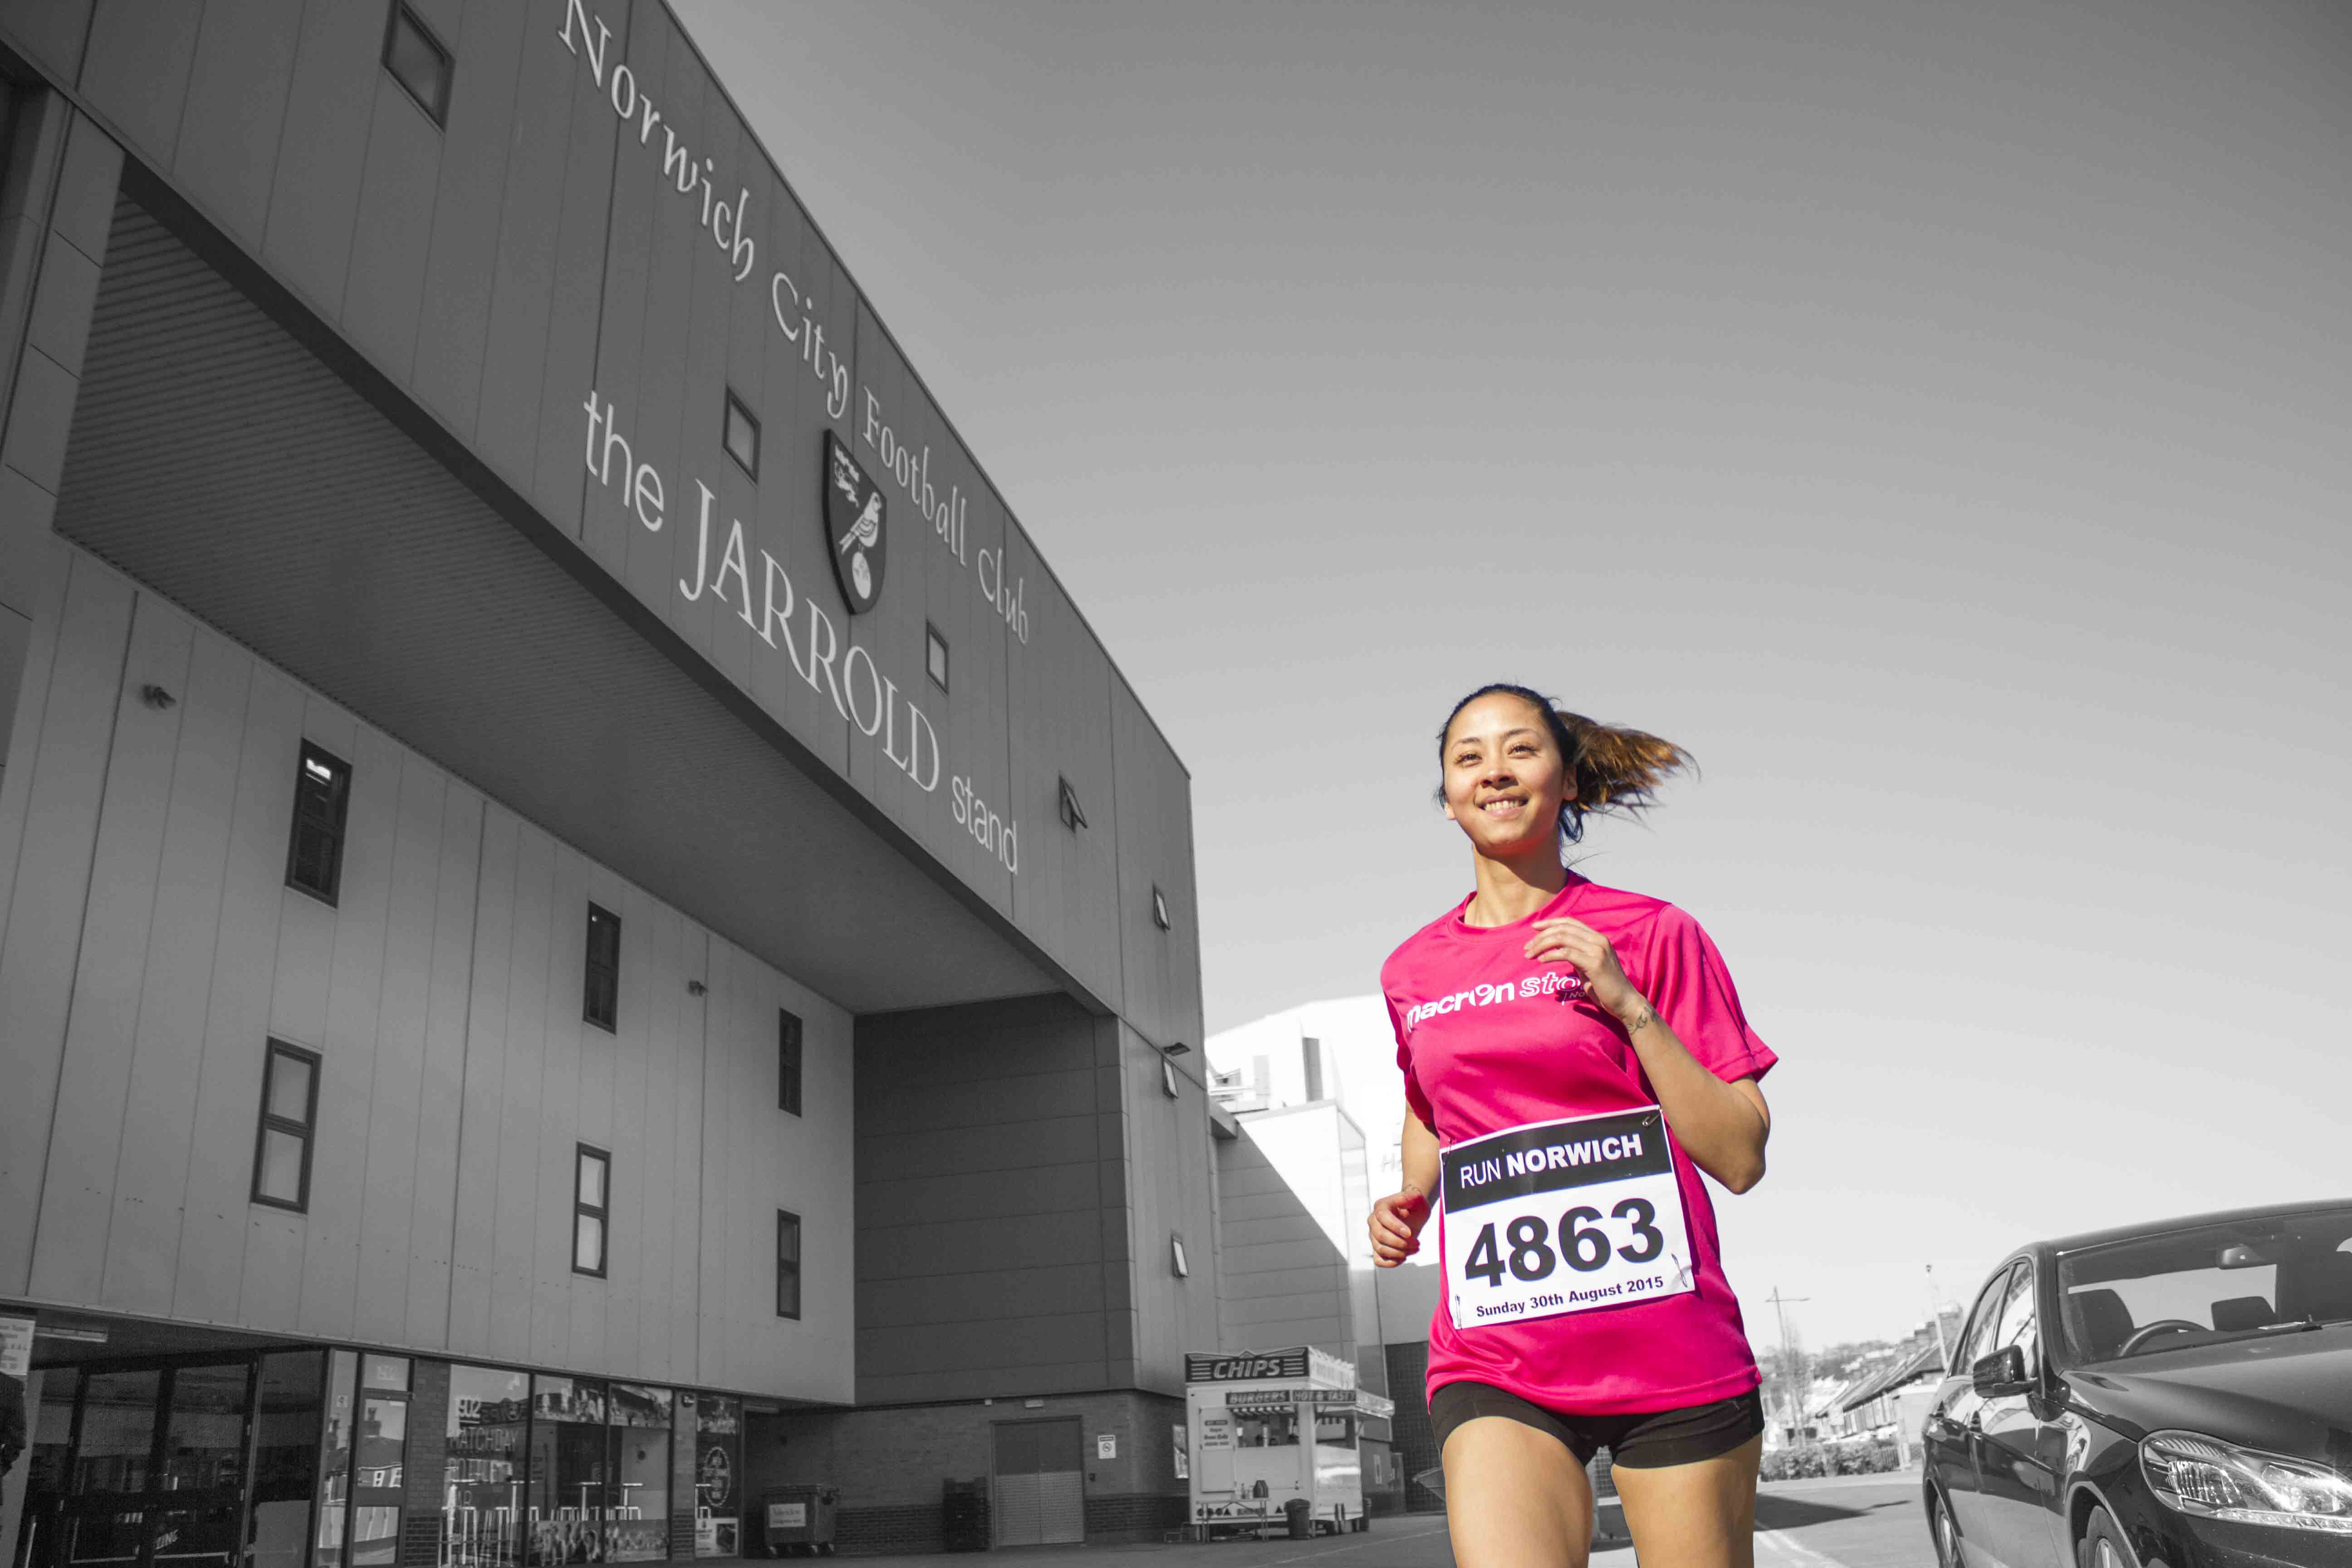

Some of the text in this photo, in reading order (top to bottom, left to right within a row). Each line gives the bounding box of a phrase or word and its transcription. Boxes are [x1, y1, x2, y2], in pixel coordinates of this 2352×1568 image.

[559, 0, 755, 281] Norwich
[771, 272, 848, 419] City
[862, 386, 966, 566] Football
[583, 390, 1018, 875] the JARROLD stand
[1460, 1132, 1643, 1189] RUN NORWICH
[1464, 1197, 1665, 1288] 4863
[1476, 1276, 1664, 1318] Sunday 30th August 2015
[1213, 1359, 1282, 1378] CHIPS
[1229, 1390, 1287, 1404] BURGERS
[1293, 1389, 1313, 1402] HOT
